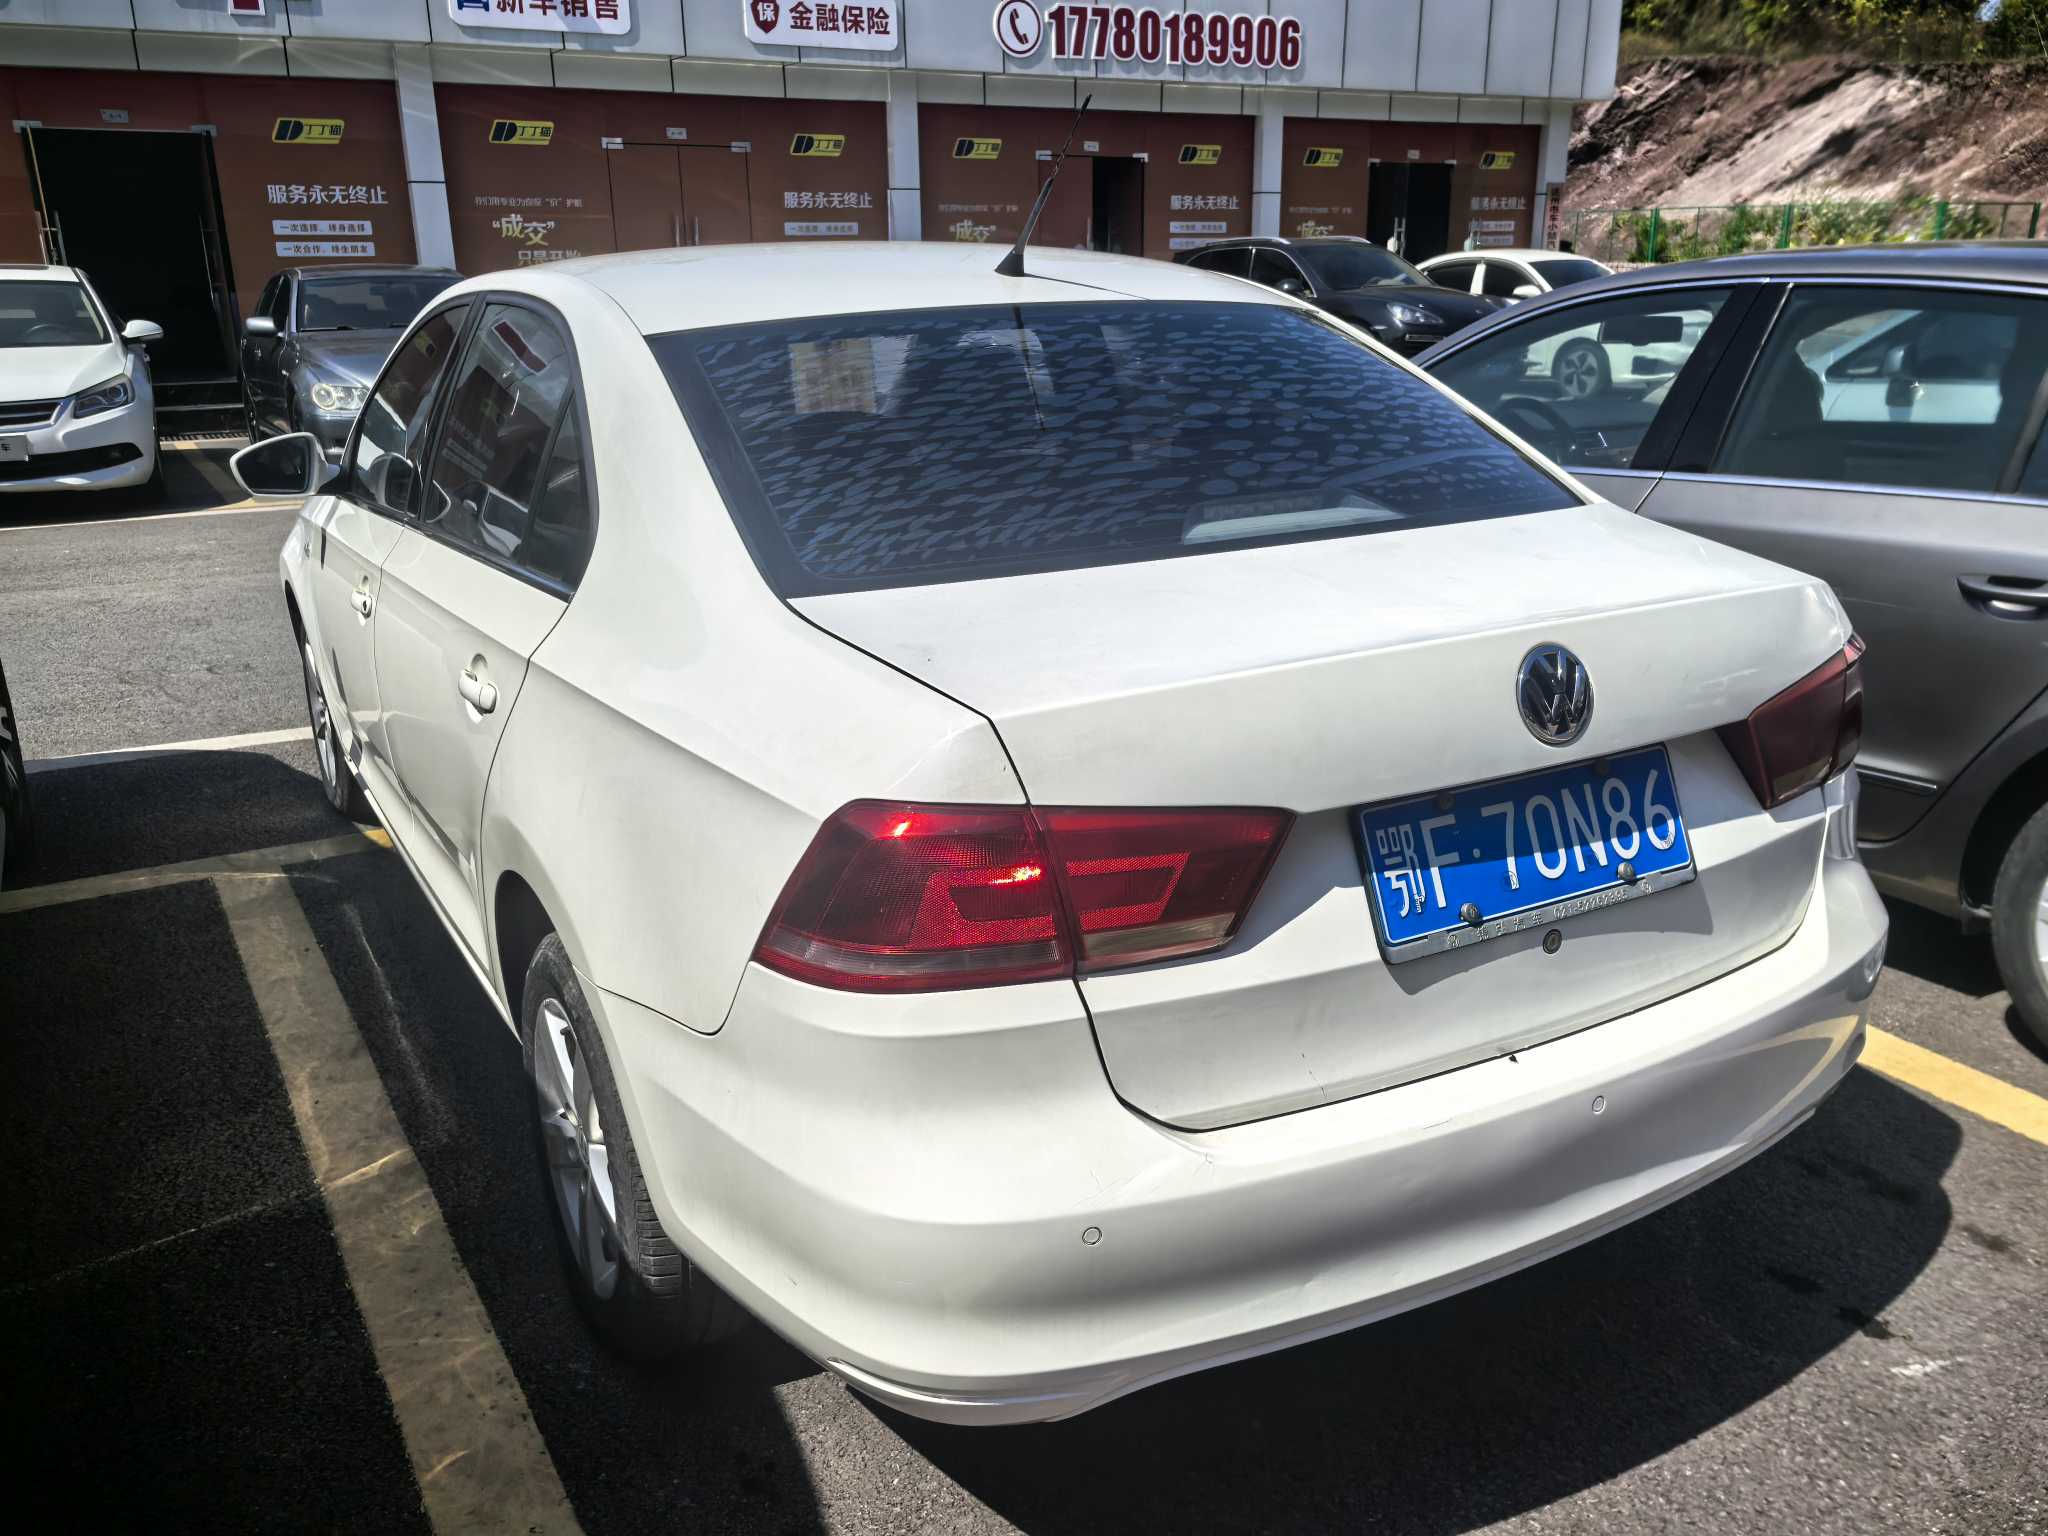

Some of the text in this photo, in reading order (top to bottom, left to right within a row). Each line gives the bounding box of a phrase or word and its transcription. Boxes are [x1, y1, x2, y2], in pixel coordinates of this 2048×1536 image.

[789, 2, 891, 35] 金融保险
[1047, 4, 1301, 69] 17780189906
[267, 184, 389, 205] 服务永无终止
[784, 191, 873, 209] 服务永无终止
